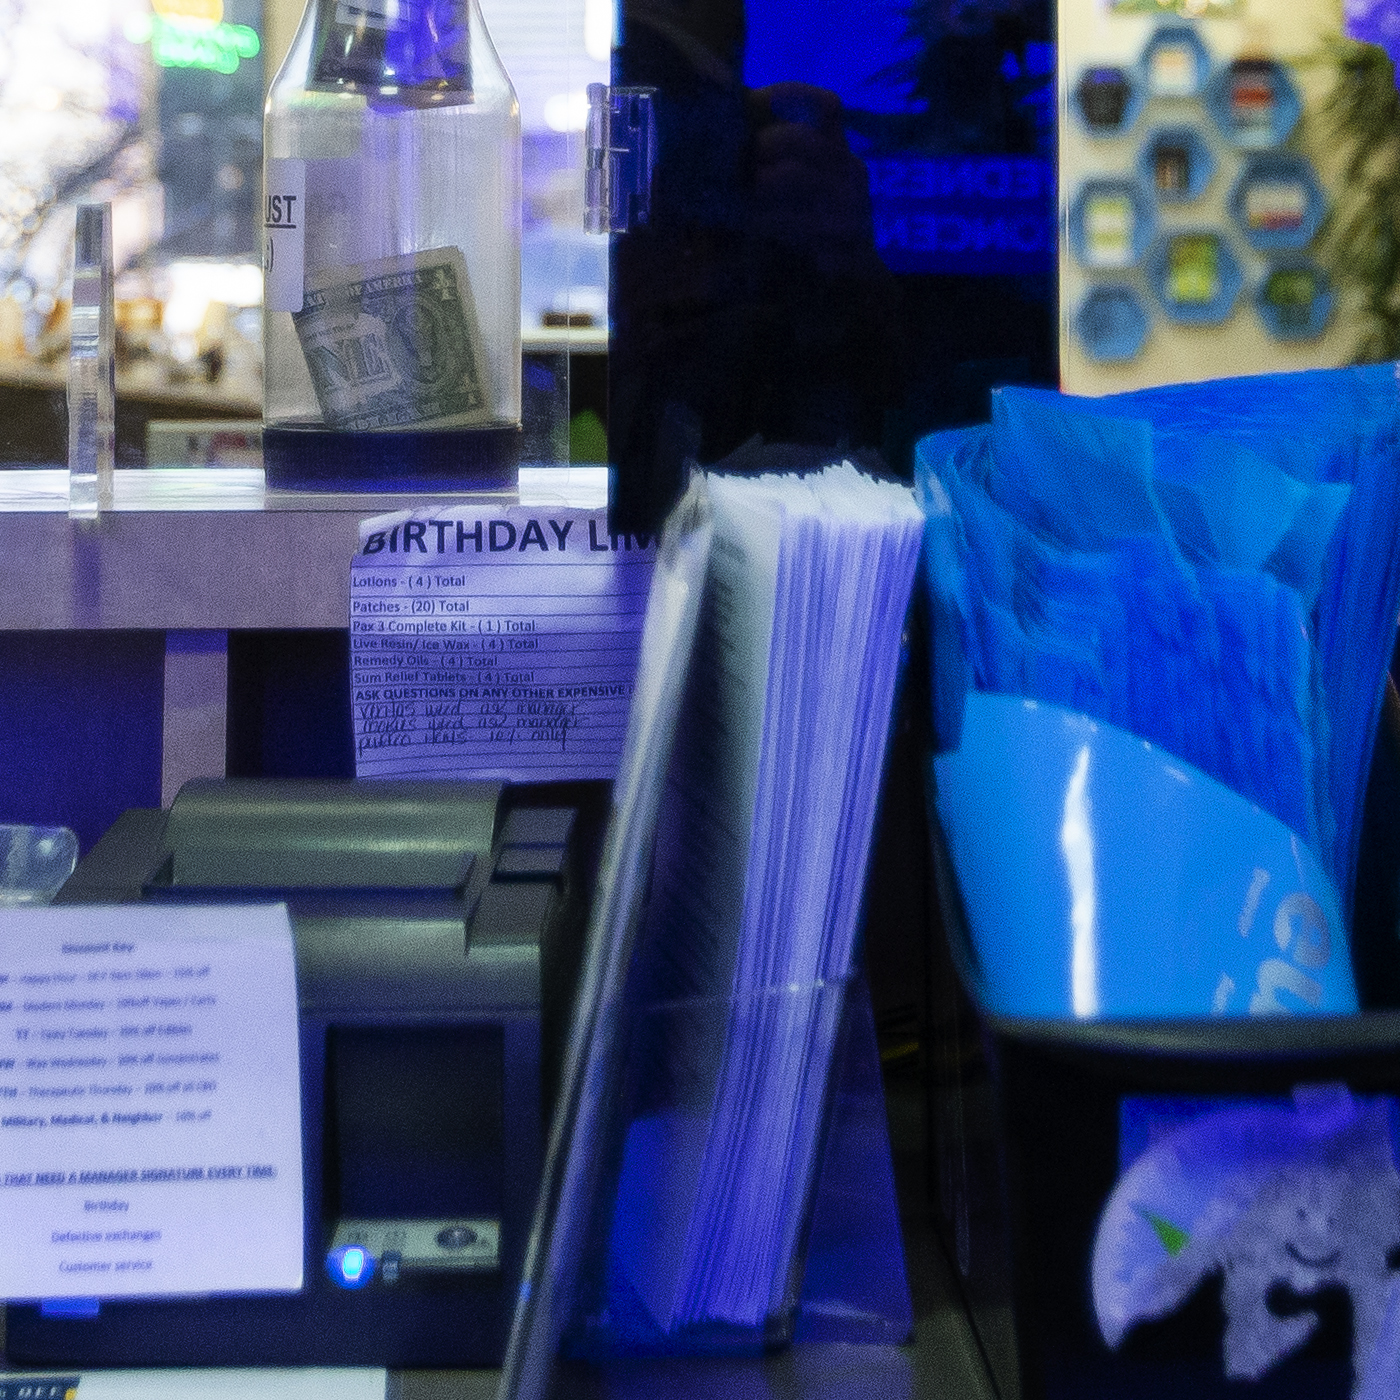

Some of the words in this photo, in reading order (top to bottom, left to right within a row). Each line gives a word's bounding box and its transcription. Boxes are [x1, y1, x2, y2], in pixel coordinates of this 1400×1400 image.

[362, 520, 575, 555] BIRTHDAY
[353, 575, 397, 589] Lotions
[435, 574, 466, 588] Total
[353, 600, 401, 613] Patches
[411, 600, 436, 615] (20)
[439, 600, 470, 613] Total
[353, 620, 375, 632] Pax
[388, 620, 447, 635] Complete
[451, 619, 467, 632] Kit
[505, 619, 536, 632] Total
[353, 638, 378, 650] Live
[443, 638, 471, 651] Wax
[508, 637, 539, 650] Total
[354, 655, 403, 670] Remedy
[467, 656, 498, 668] Total
[504, 670, 534, 684] Total
[356, 688, 380, 702] ASK
[383, 686, 455, 701] QUESTIONS
[459, 686, 479, 700] ON
[481, 686, 508, 700] ANY
[512, 685, 554, 699] OTHER
[559, 683, 625, 699] EXPENSIVE
[59, 1260, 112, 1275] Customer
